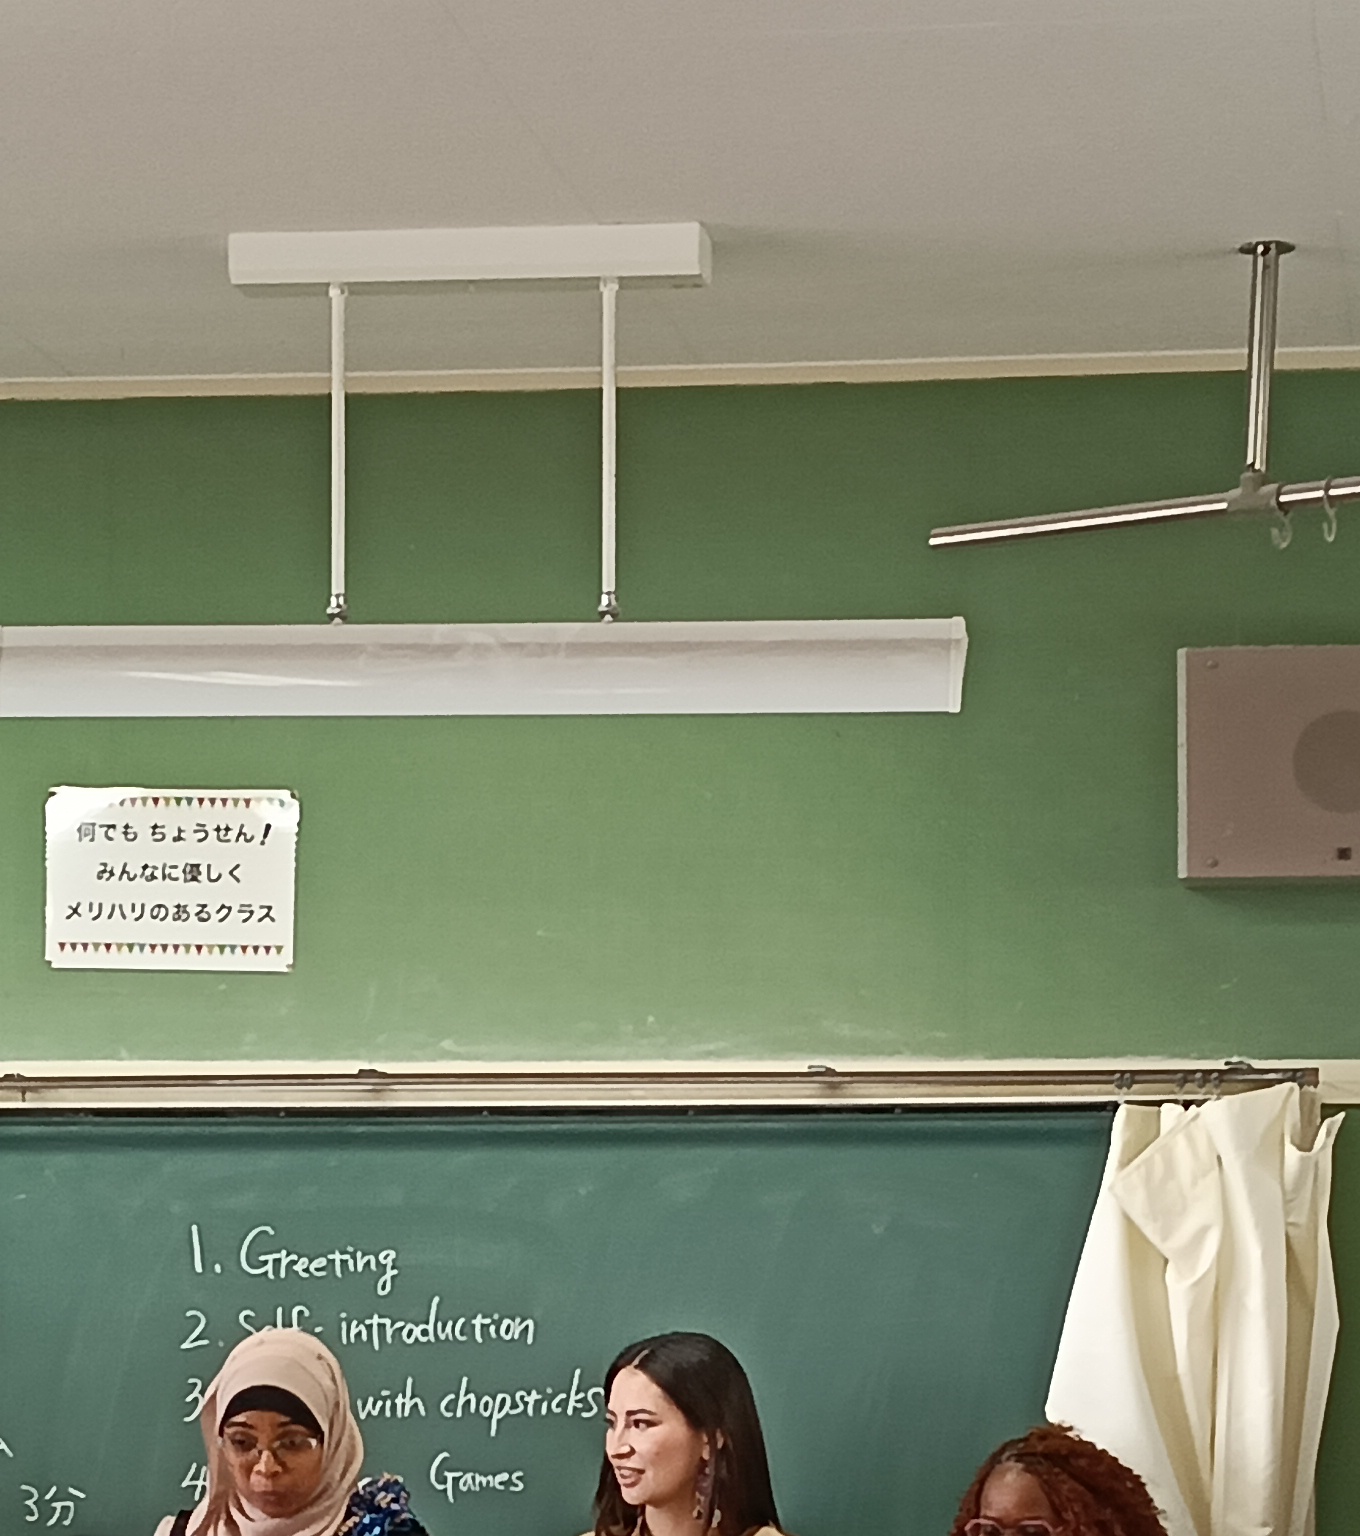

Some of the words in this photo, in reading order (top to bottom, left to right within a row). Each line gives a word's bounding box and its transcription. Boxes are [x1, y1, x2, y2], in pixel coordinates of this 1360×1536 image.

[76, 821, 139, 843] 何でも
[95, 861, 242, 884] みんなに優しく
[65, 901, 277, 923] メリハリのあるクラス
[191, 1224, 222, 1274] 1.
[240, 1225, 399, 1296] Greeting
[356, 1376, 426, 1420] with
[439, 1368, 606, 1438] chopsticks
[429, 1452, 526, 1503] Games
[19, 1484, 87, 1527] 3分
